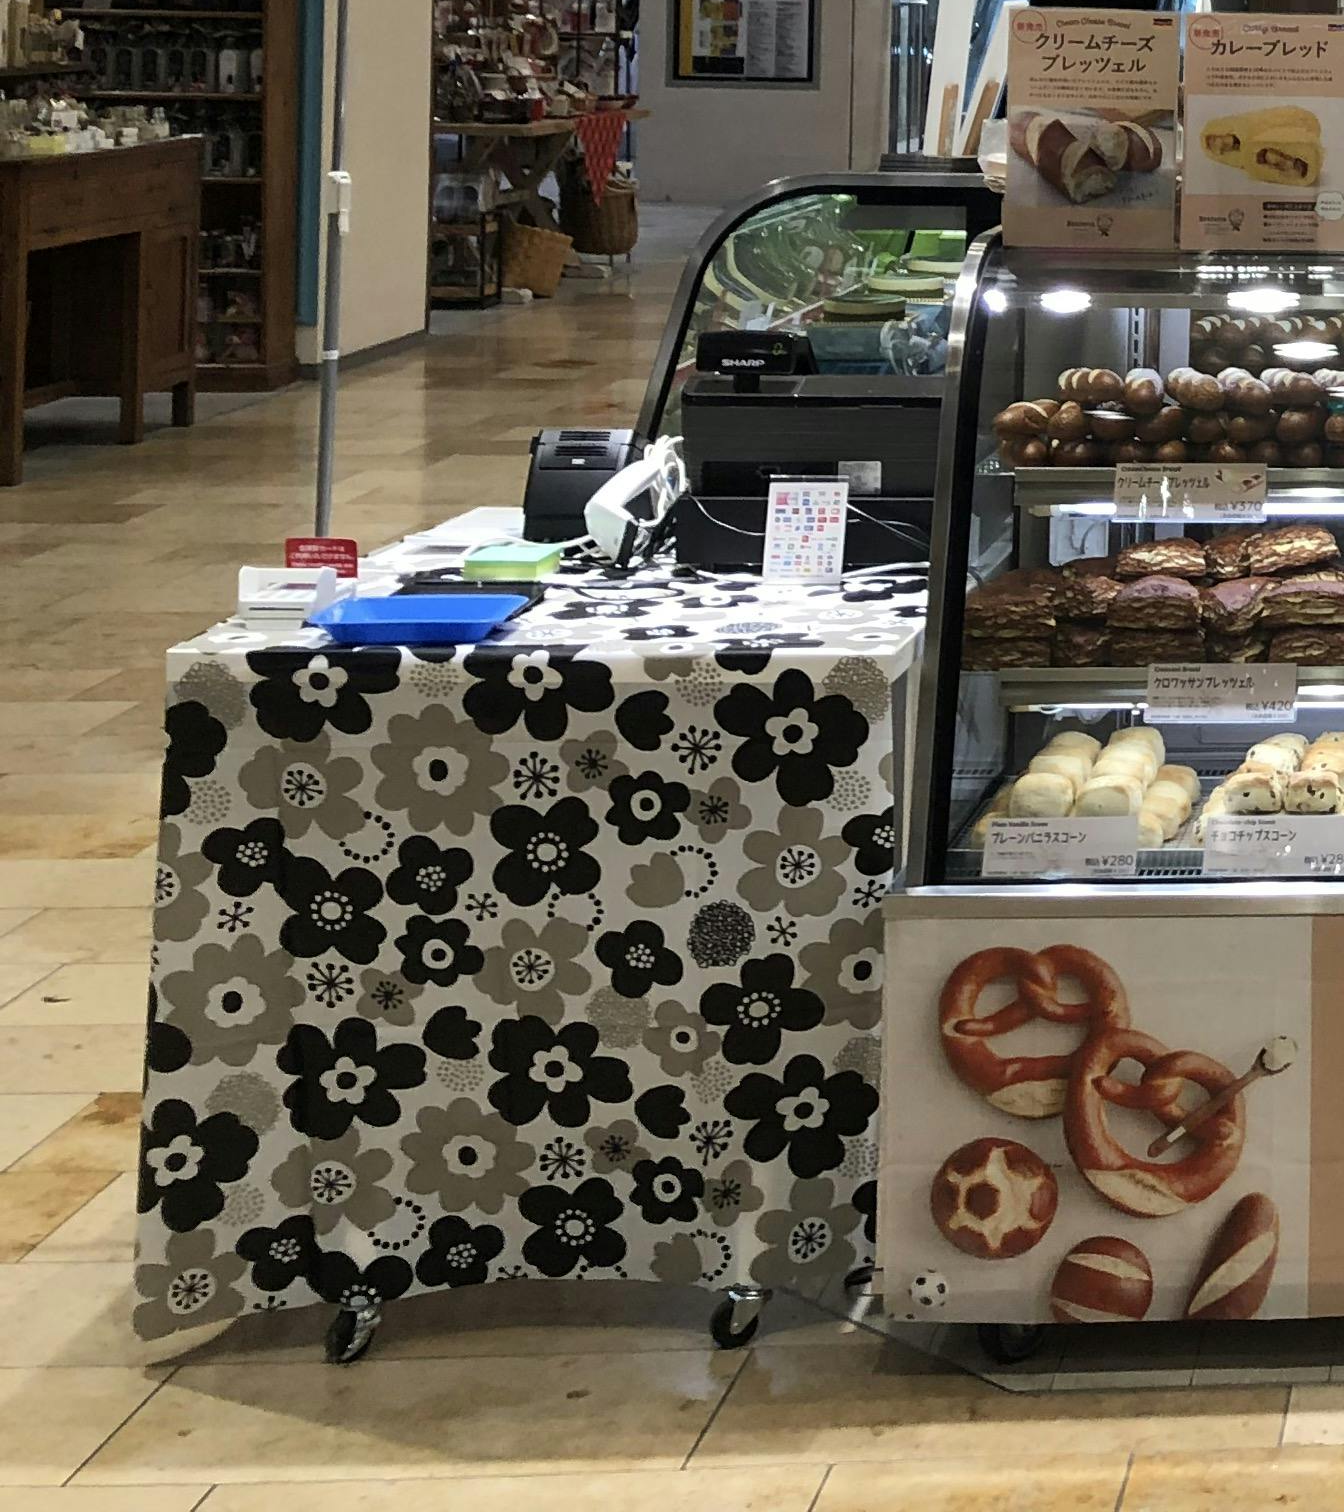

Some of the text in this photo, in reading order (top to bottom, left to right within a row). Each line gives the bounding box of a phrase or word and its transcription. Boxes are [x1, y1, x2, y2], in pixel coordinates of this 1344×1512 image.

[1035, 33, 1155, 52] クリームチーズ
[1210, 39, 1329, 59] カレーブレッド
[1041, 55, 1146, 73] ブレッツェル
[722, 358, 765, 367] SHARP
